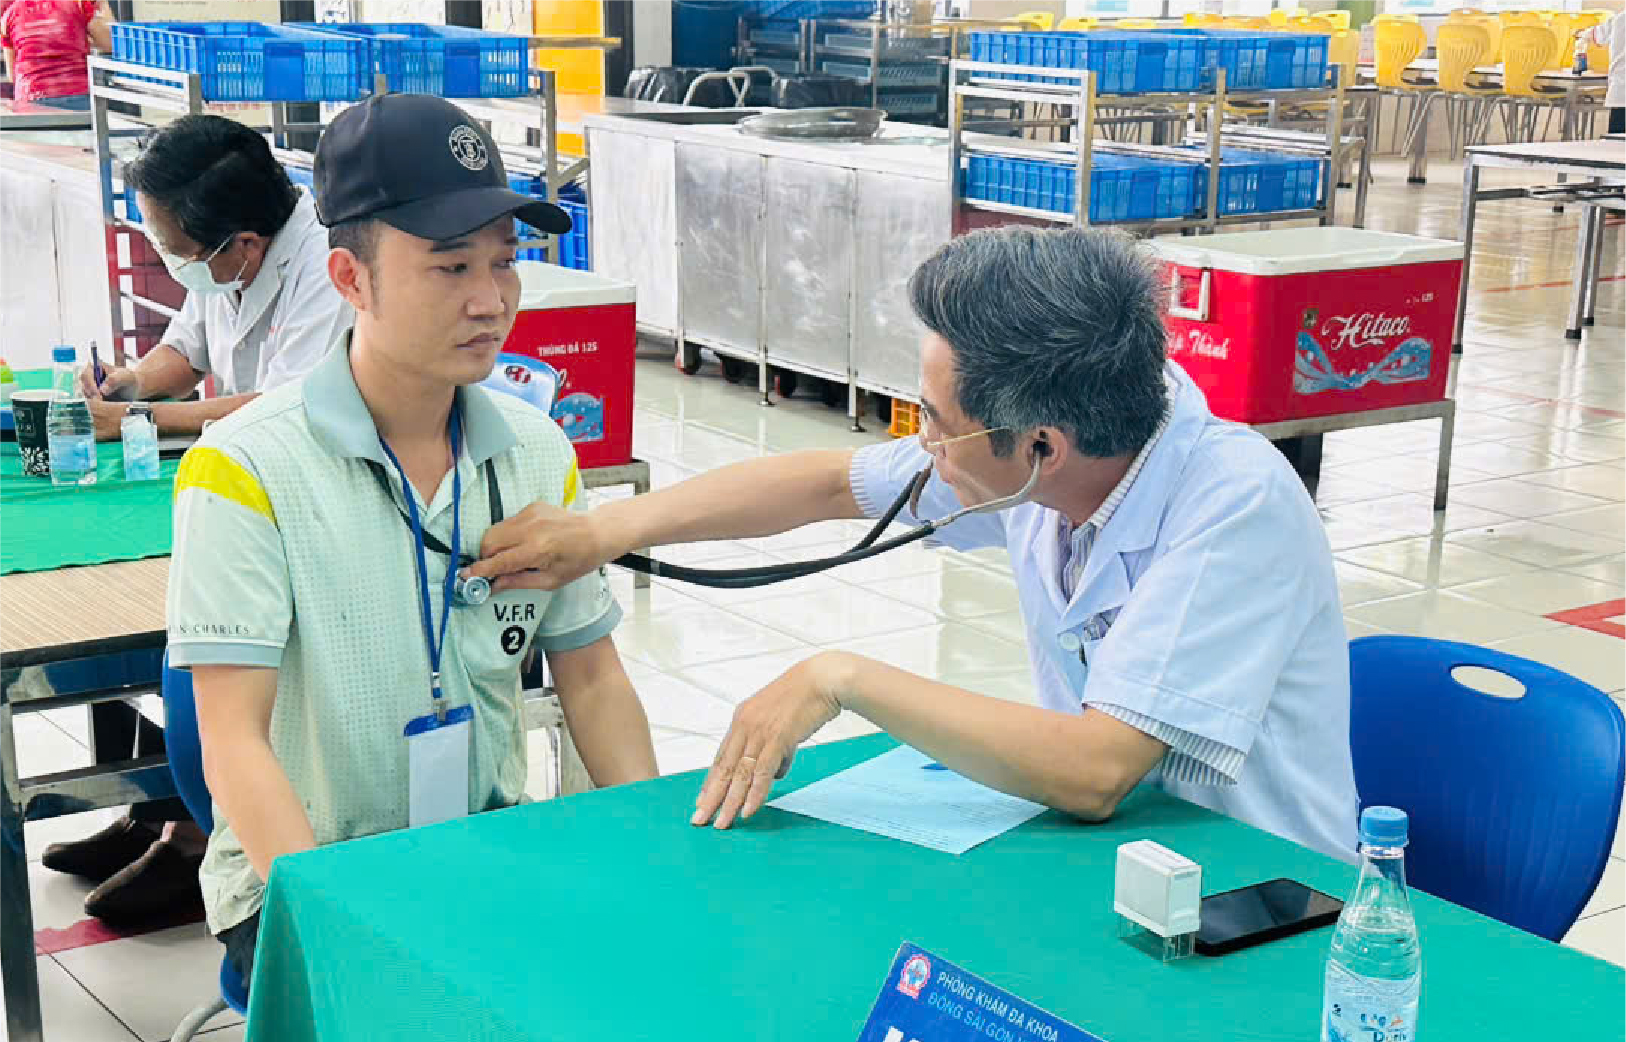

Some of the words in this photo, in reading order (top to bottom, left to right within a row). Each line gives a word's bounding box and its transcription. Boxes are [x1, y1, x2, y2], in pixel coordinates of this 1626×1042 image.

[493, 603, 535, 622] V.F.R
[193, 623, 249, 635] CHARLES
[937, 970, 976, 1001] PHÒNG
[975, 993, 1008, 1018] KHÁM
